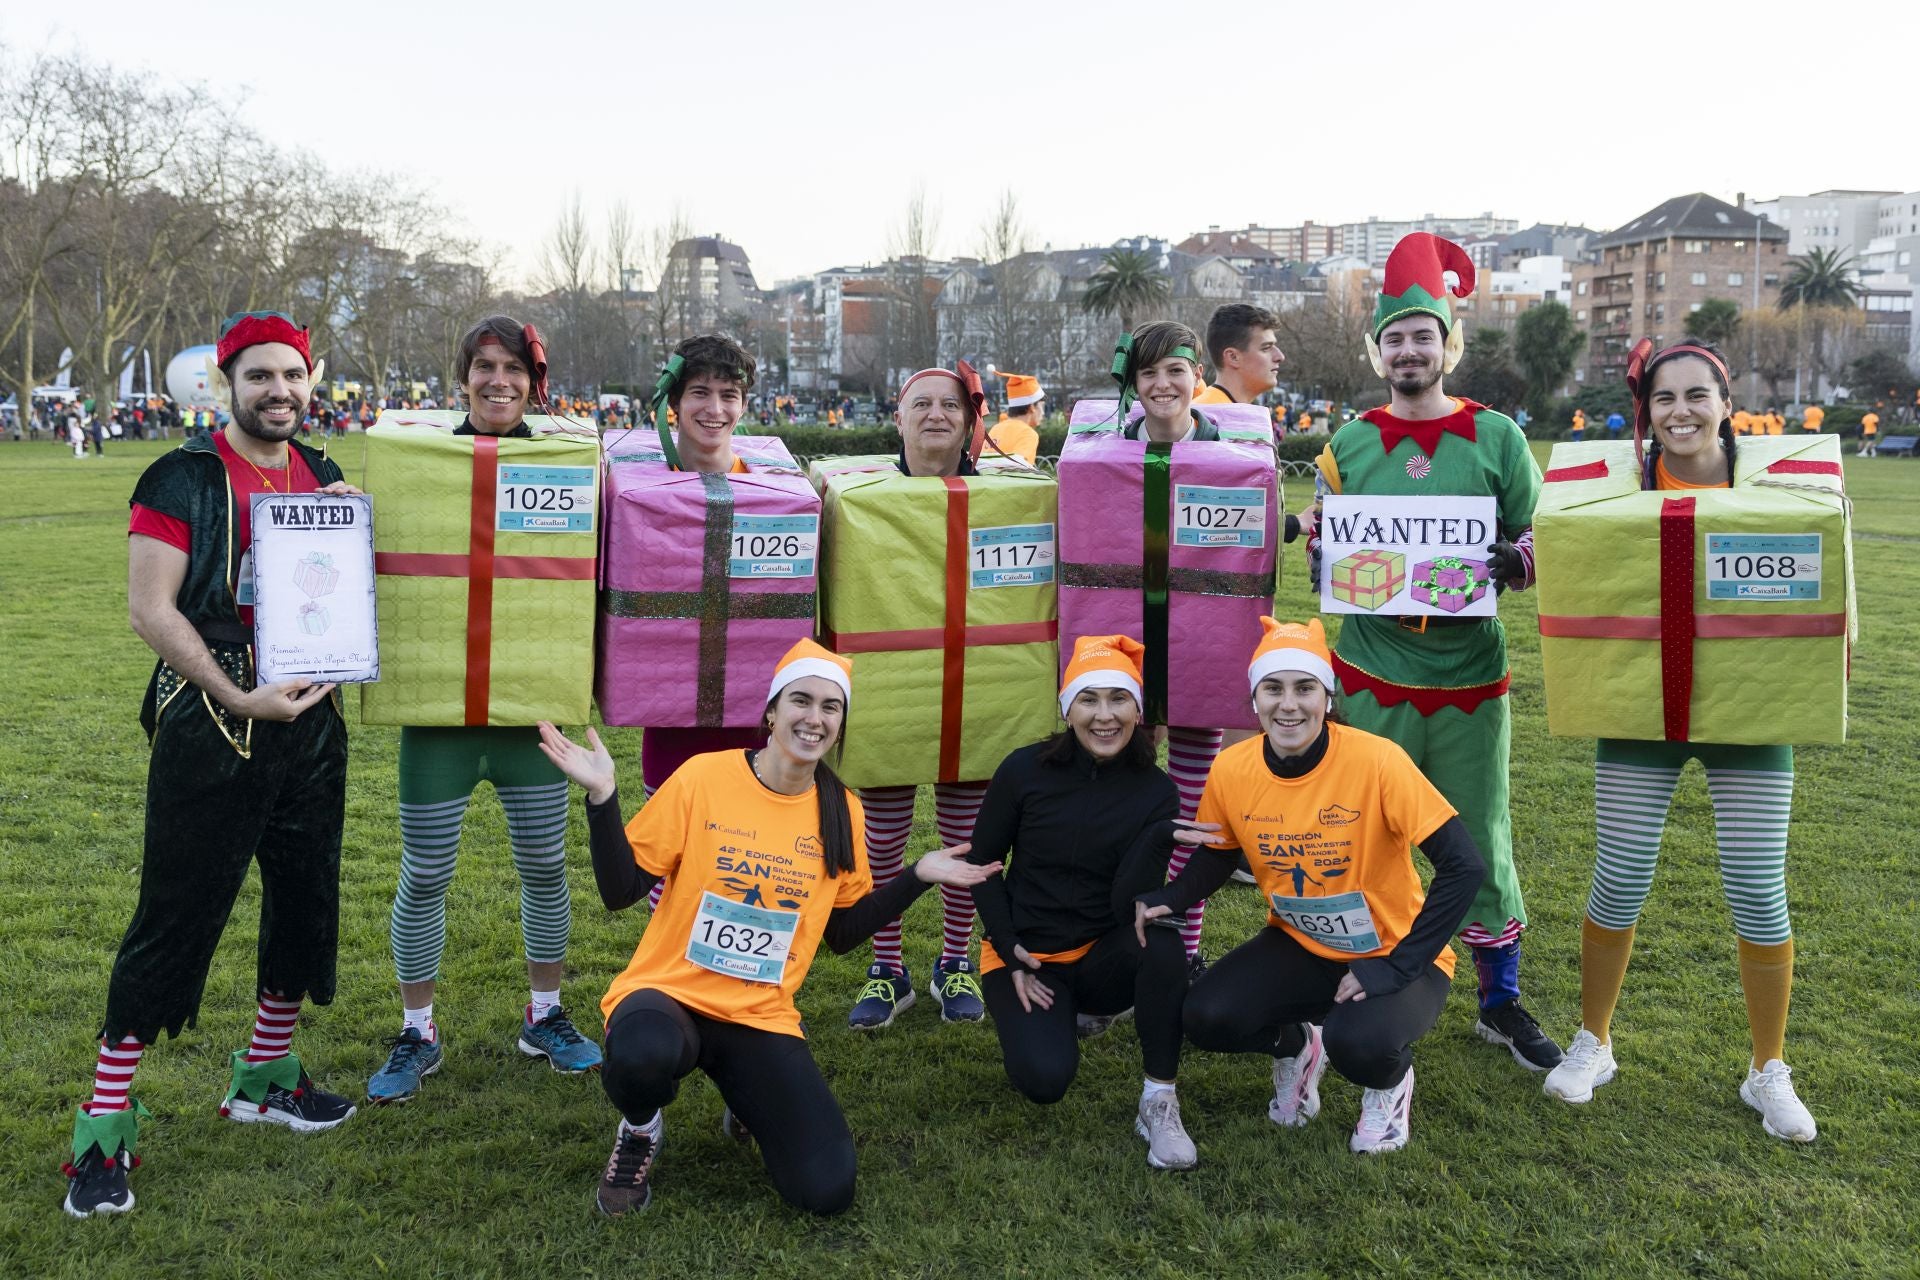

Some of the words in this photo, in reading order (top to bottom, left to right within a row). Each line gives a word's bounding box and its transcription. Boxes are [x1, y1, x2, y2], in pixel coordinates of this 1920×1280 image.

[504, 487, 574, 511] 1025
[270, 504, 355, 525] WANTED
[534, 518, 567, 527] CaixaBank
[1182, 505, 1246, 528] 1027
[1328, 511, 1488, 546] WANTED
[734, 535, 799, 558] 1026
[976, 545, 1037, 568] 1117
[1715, 555, 1796, 579] 1068
[1750, 586, 1788, 595] CaixaBank
[1277, 832, 1322, 841] EDICIÓN
[745, 850, 793, 866] EDICIÓN
[1258, 843, 1305, 857] SAN
[1304, 840, 1352, 849] SILVESTRE
[1306, 849, 1338, 857] TANDER
[716, 856, 772, 879] SAN
[772, 866, 817, 881] SILVESTRE
[1314, 855, 1352, 866] 2024
[771, 874, 803, 886] TANDER
[774, 884, 810, 898] 2024
[1286, 912, 1349, 935] 1631
[703, 919, 773, 957] 1632
[724, 959, 757, 973] CaixaBank
